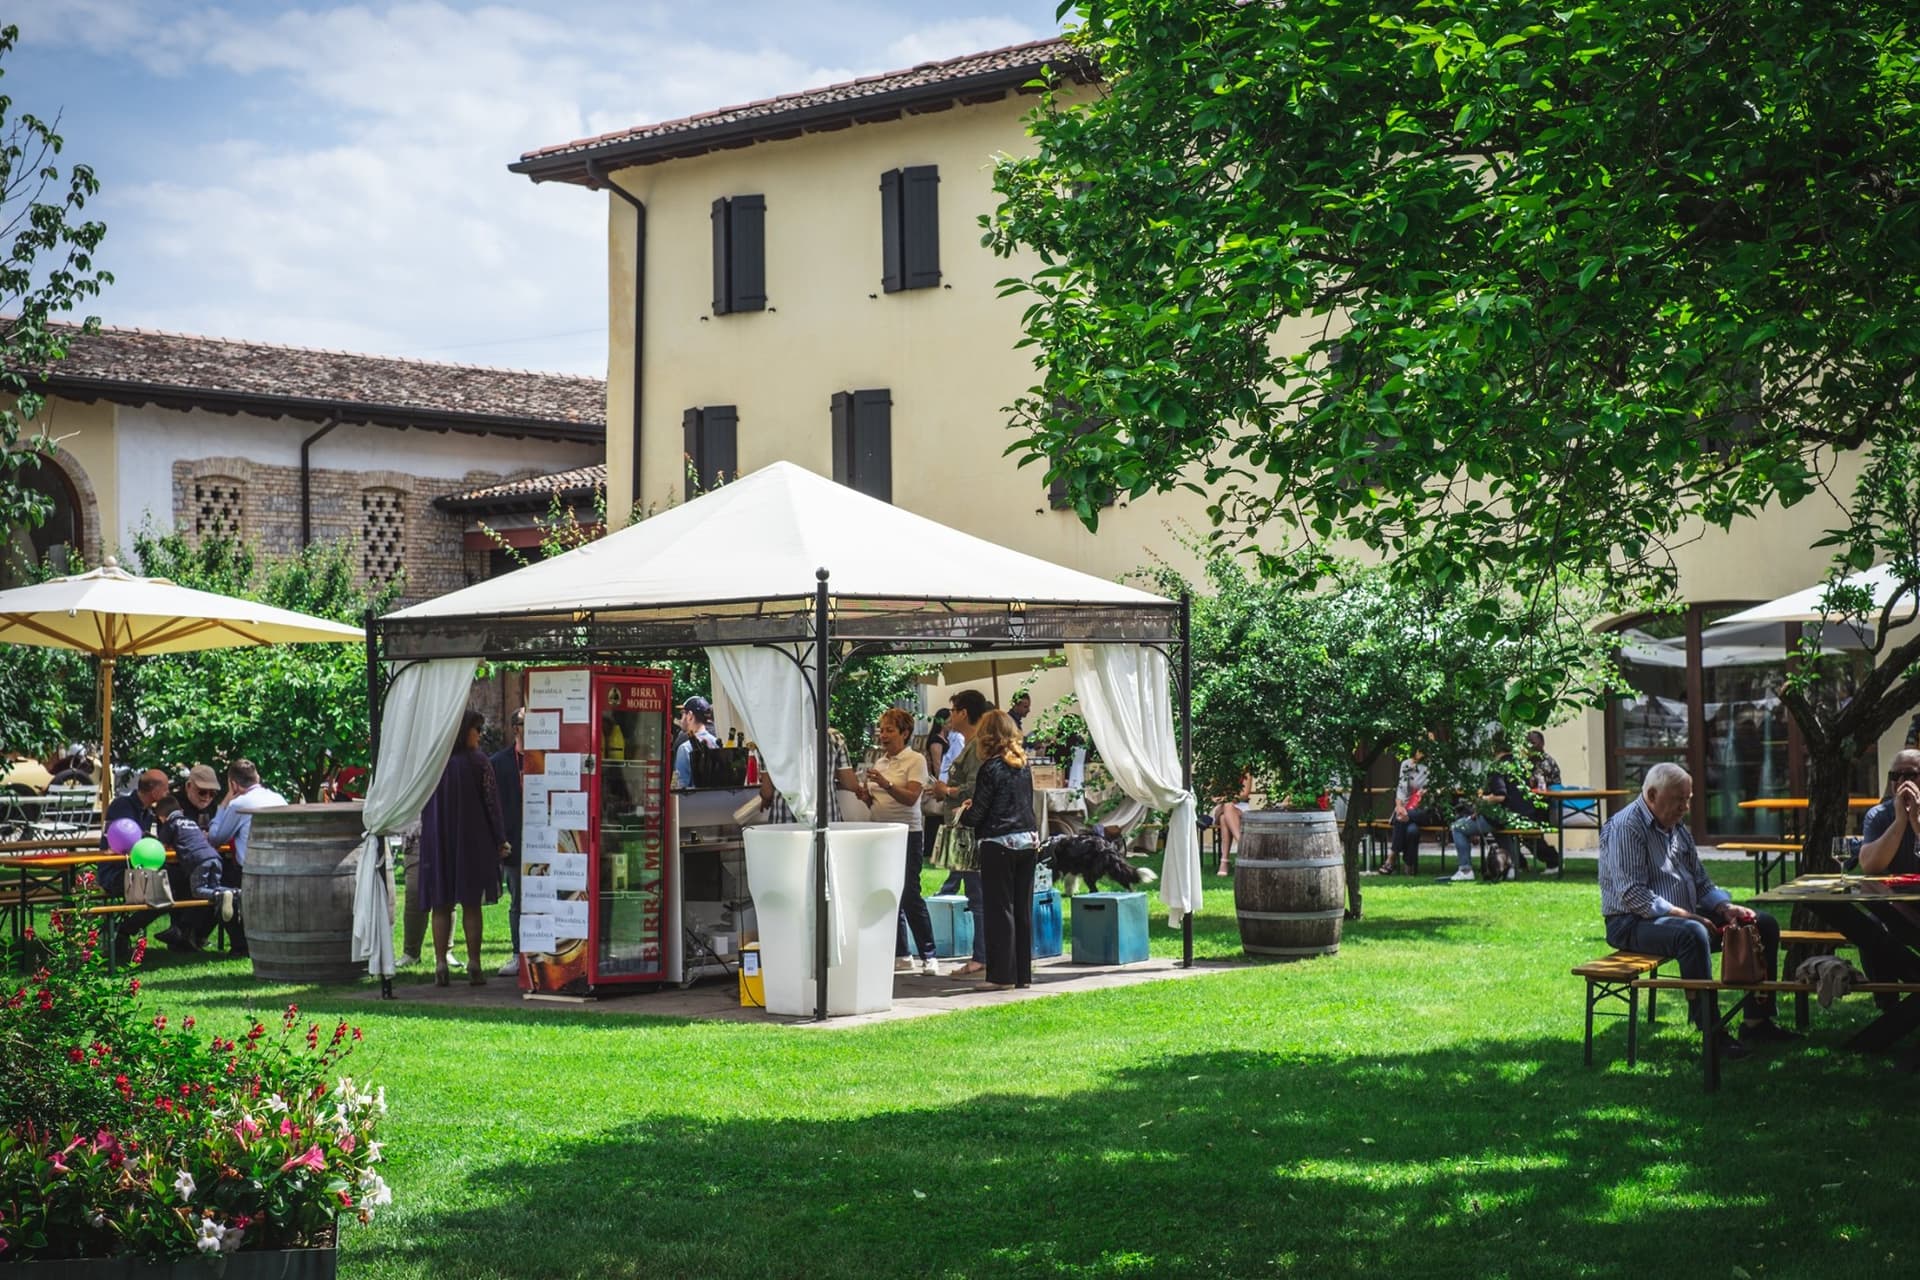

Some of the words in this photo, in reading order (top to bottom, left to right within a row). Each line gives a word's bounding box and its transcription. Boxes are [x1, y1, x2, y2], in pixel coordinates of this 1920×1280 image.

[627, 698, 662, 710] MORETTI
[631, 687, 657, 698] BIRRA
[643, 759, 661, 871] MORETTI
[643, 880, 660, 962] BIRRA
